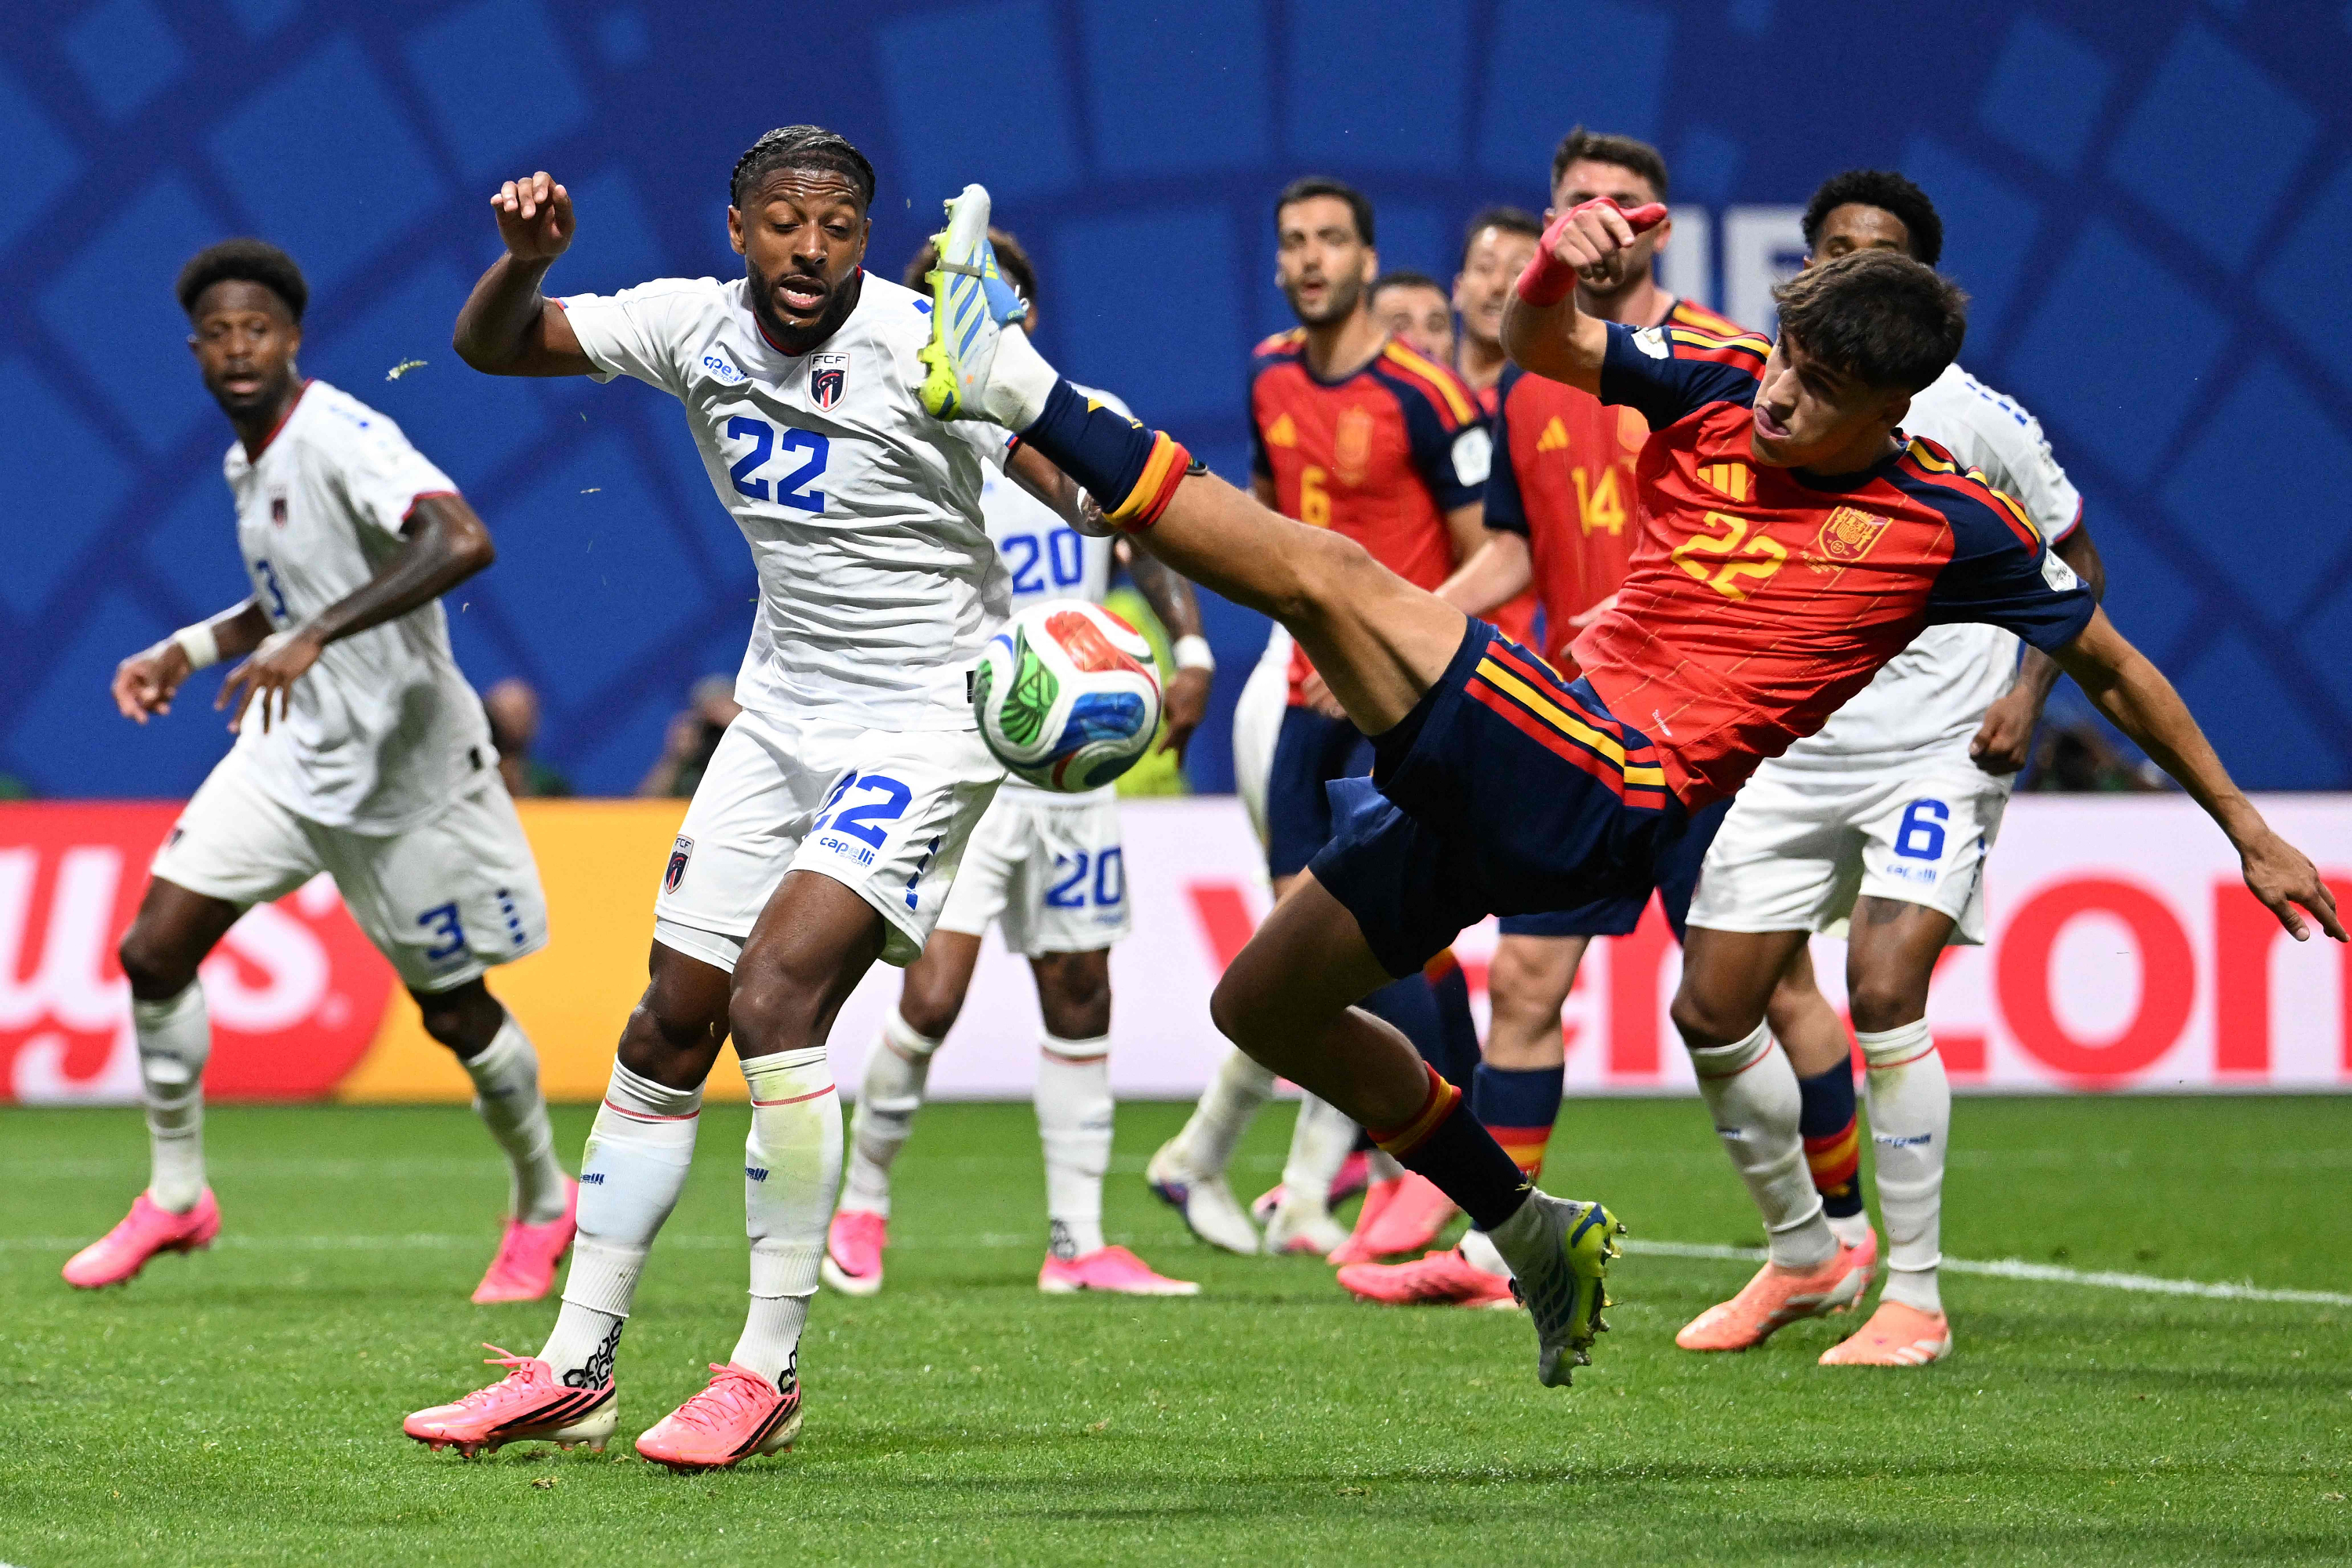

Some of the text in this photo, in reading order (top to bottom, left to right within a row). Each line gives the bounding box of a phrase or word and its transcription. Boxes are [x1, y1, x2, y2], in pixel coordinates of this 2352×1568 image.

[812, 355, 846, 365] FCF
[727, 416, 829, 514] 22
[1300, 463, 1332, 530] 6
[1570, 466, 1627, 536] 14
[1000, 527, 1083, 594] 20
[1670, 510, 1788, 602] 22
[1893, 798, 1950, 862] 6
[1045, 847, 1123, 908] 20
[417, 899, 465, 961] 3
